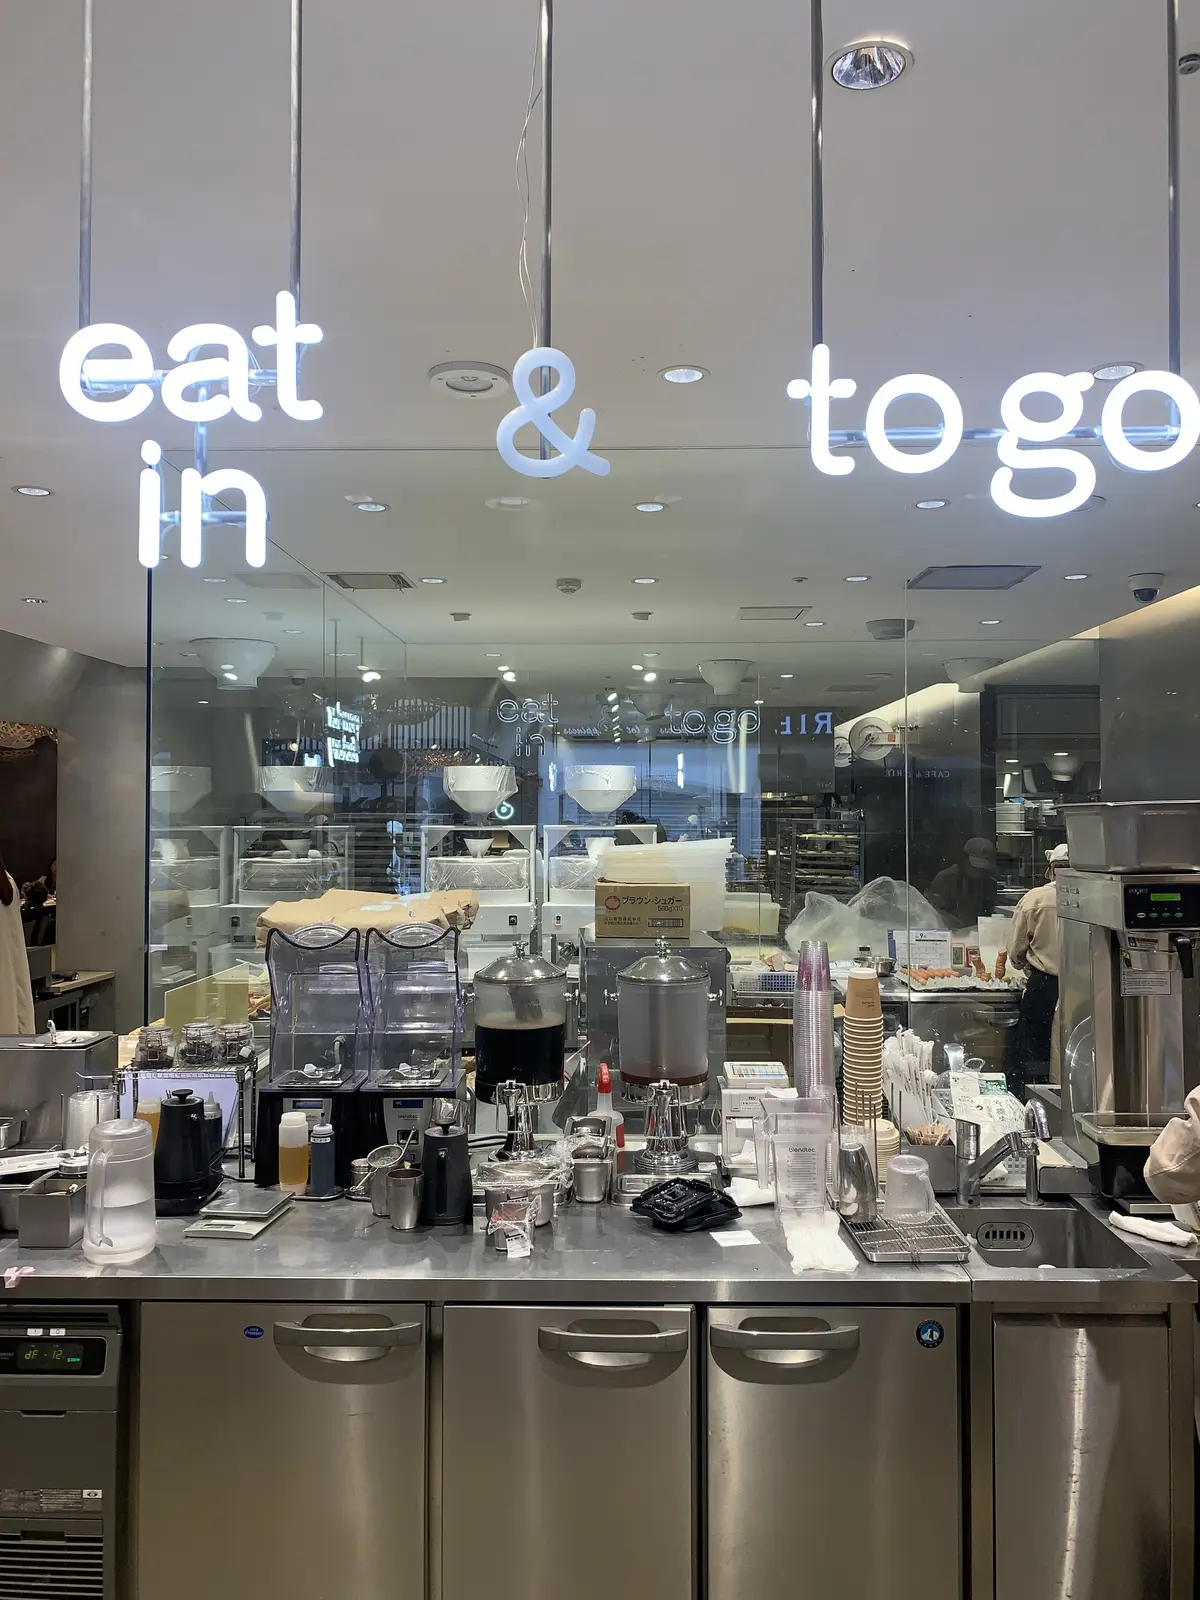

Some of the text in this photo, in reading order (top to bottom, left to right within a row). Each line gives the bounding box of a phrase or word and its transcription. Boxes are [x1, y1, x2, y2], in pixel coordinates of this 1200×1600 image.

[59, 290, 324, 423] eat
[496, 347, 610, 478] &
[786, 343, 1200, 519] to go
[138, 439, 267, 569] in
[497, 693, 559, 723] eat
[515, 727, 545, 757] in
[664, 703, 760, 744] to go
[621, 896, 683, 905] ブラウン・シュガー
